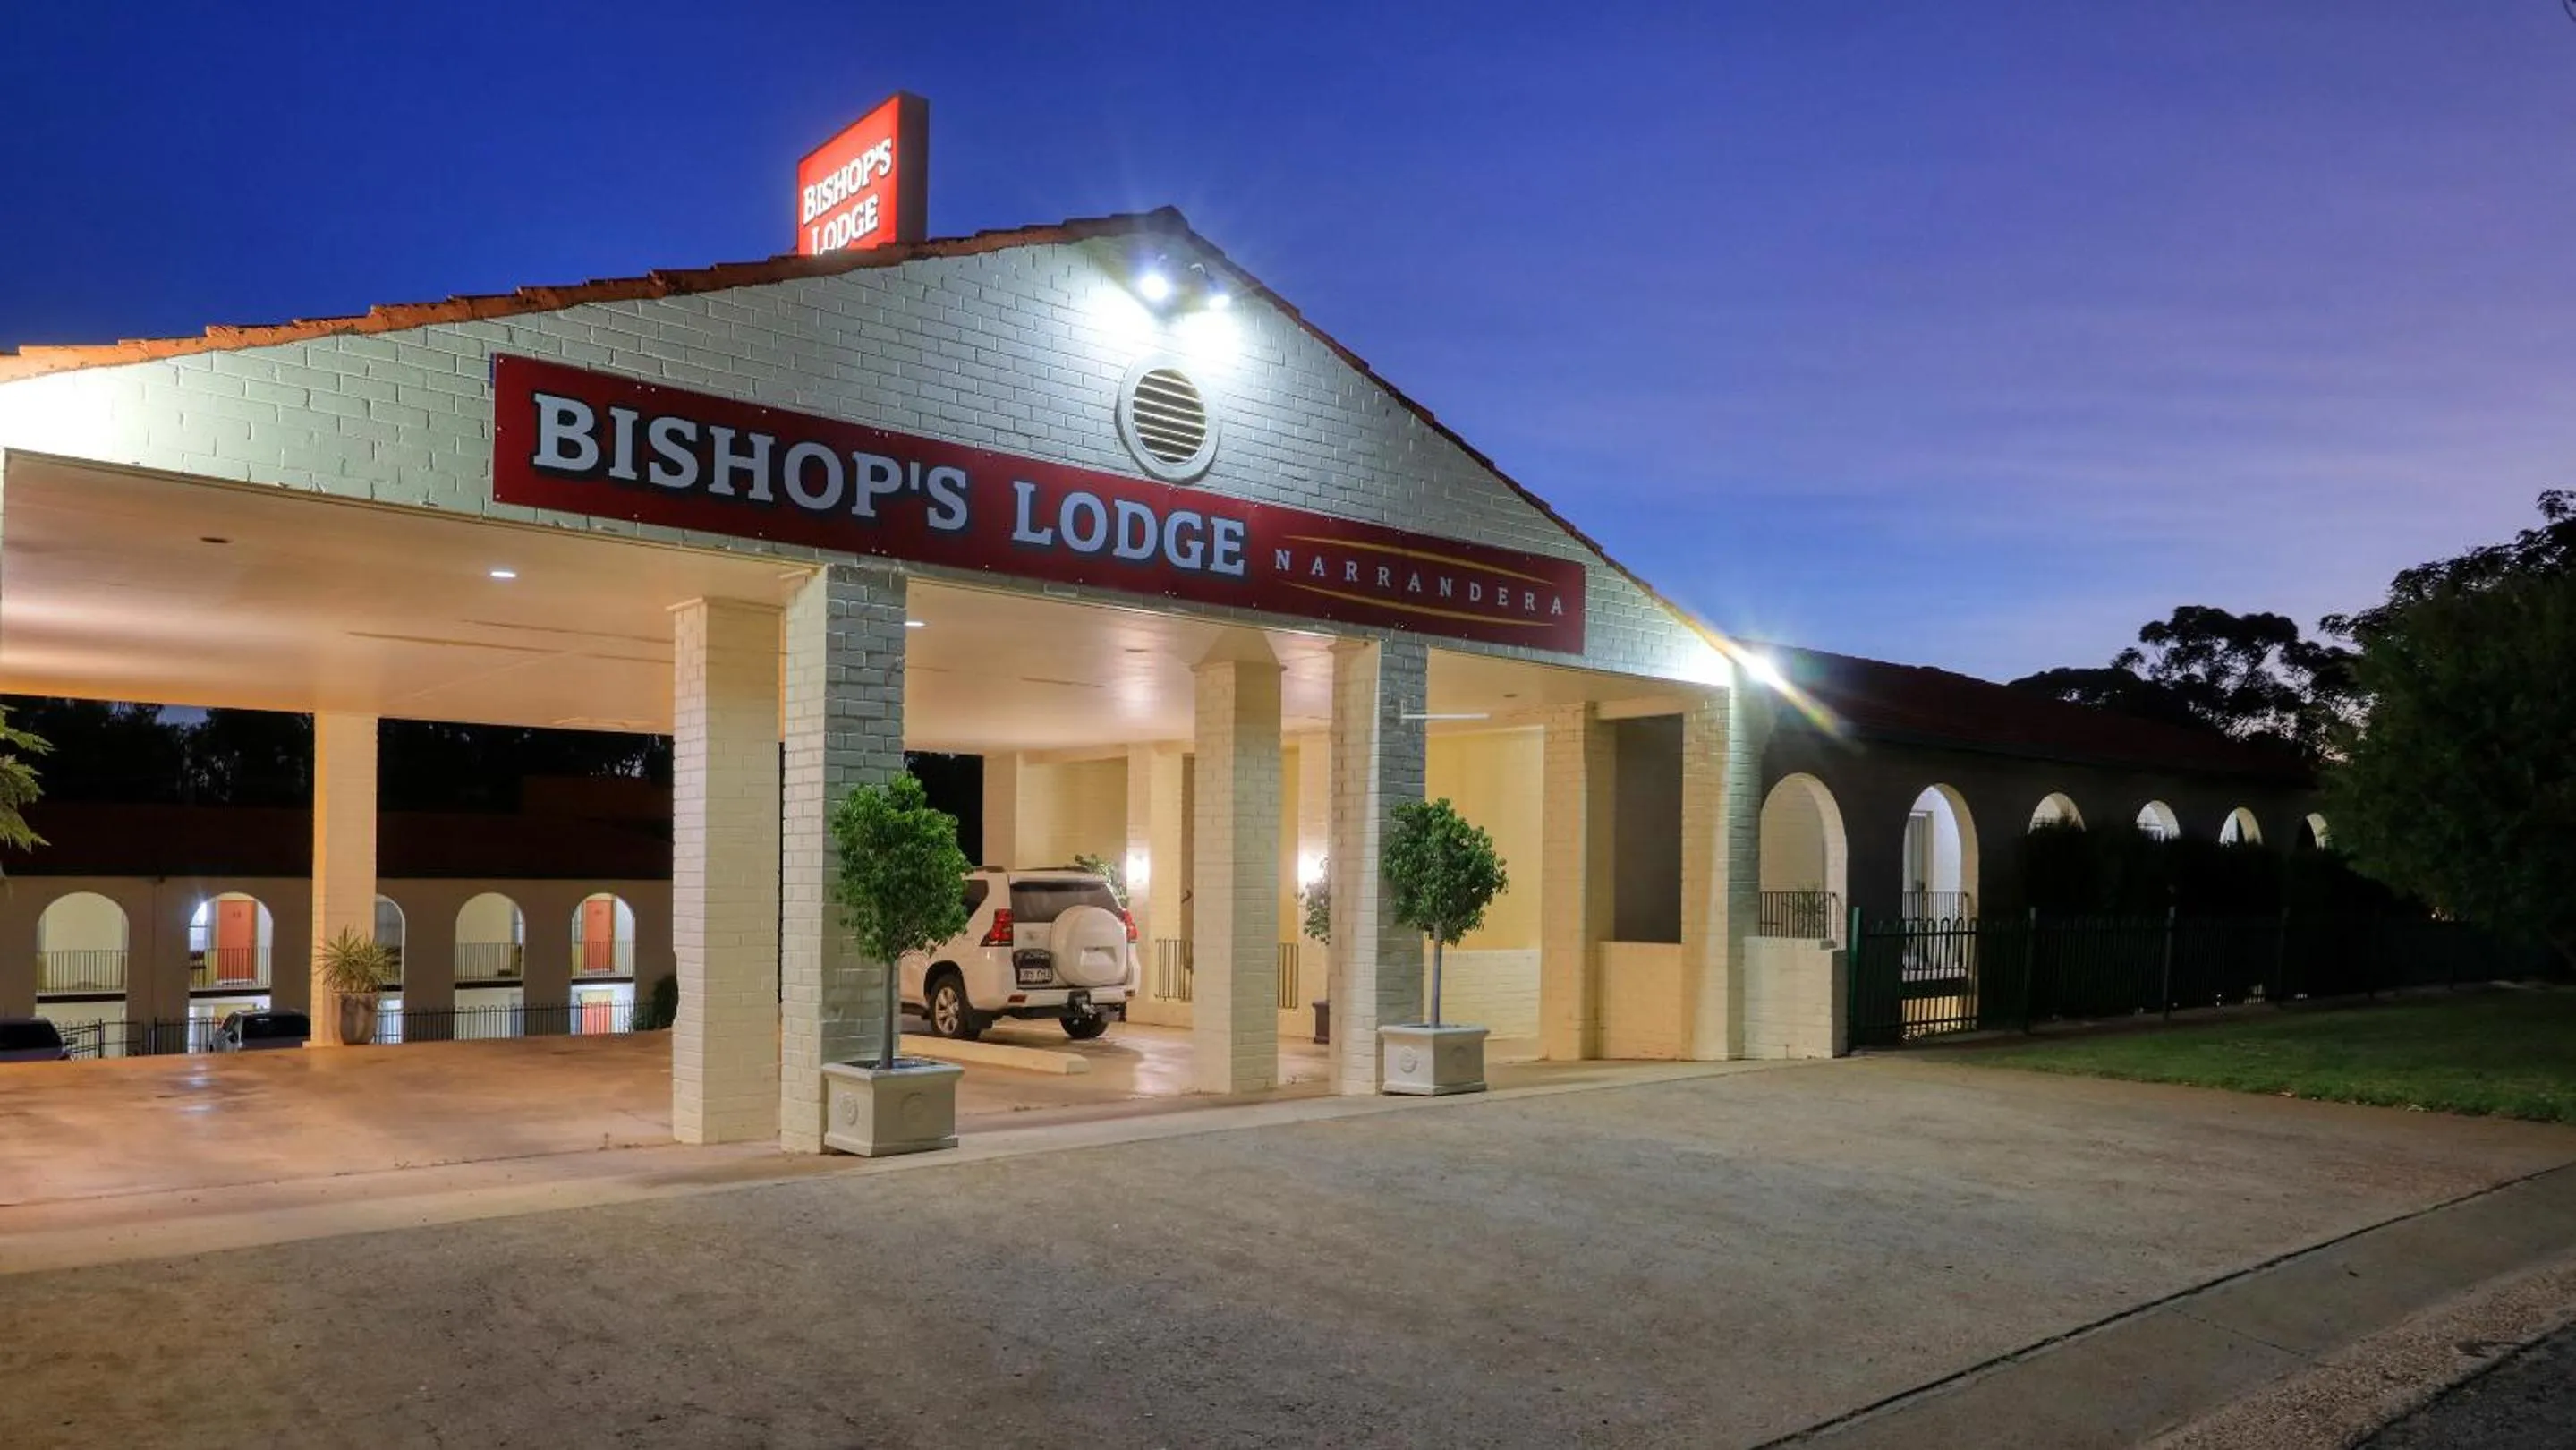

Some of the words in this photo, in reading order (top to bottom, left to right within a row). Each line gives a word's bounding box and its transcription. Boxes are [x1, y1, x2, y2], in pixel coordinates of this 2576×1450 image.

[803, 137, 892, 225] BISHOP'S
[533, 392, 969, 531] BISHOP'S
[1011, 480, 1246, 576] LODGE
[1274, 549, 1564, 616] NARRANDERA
